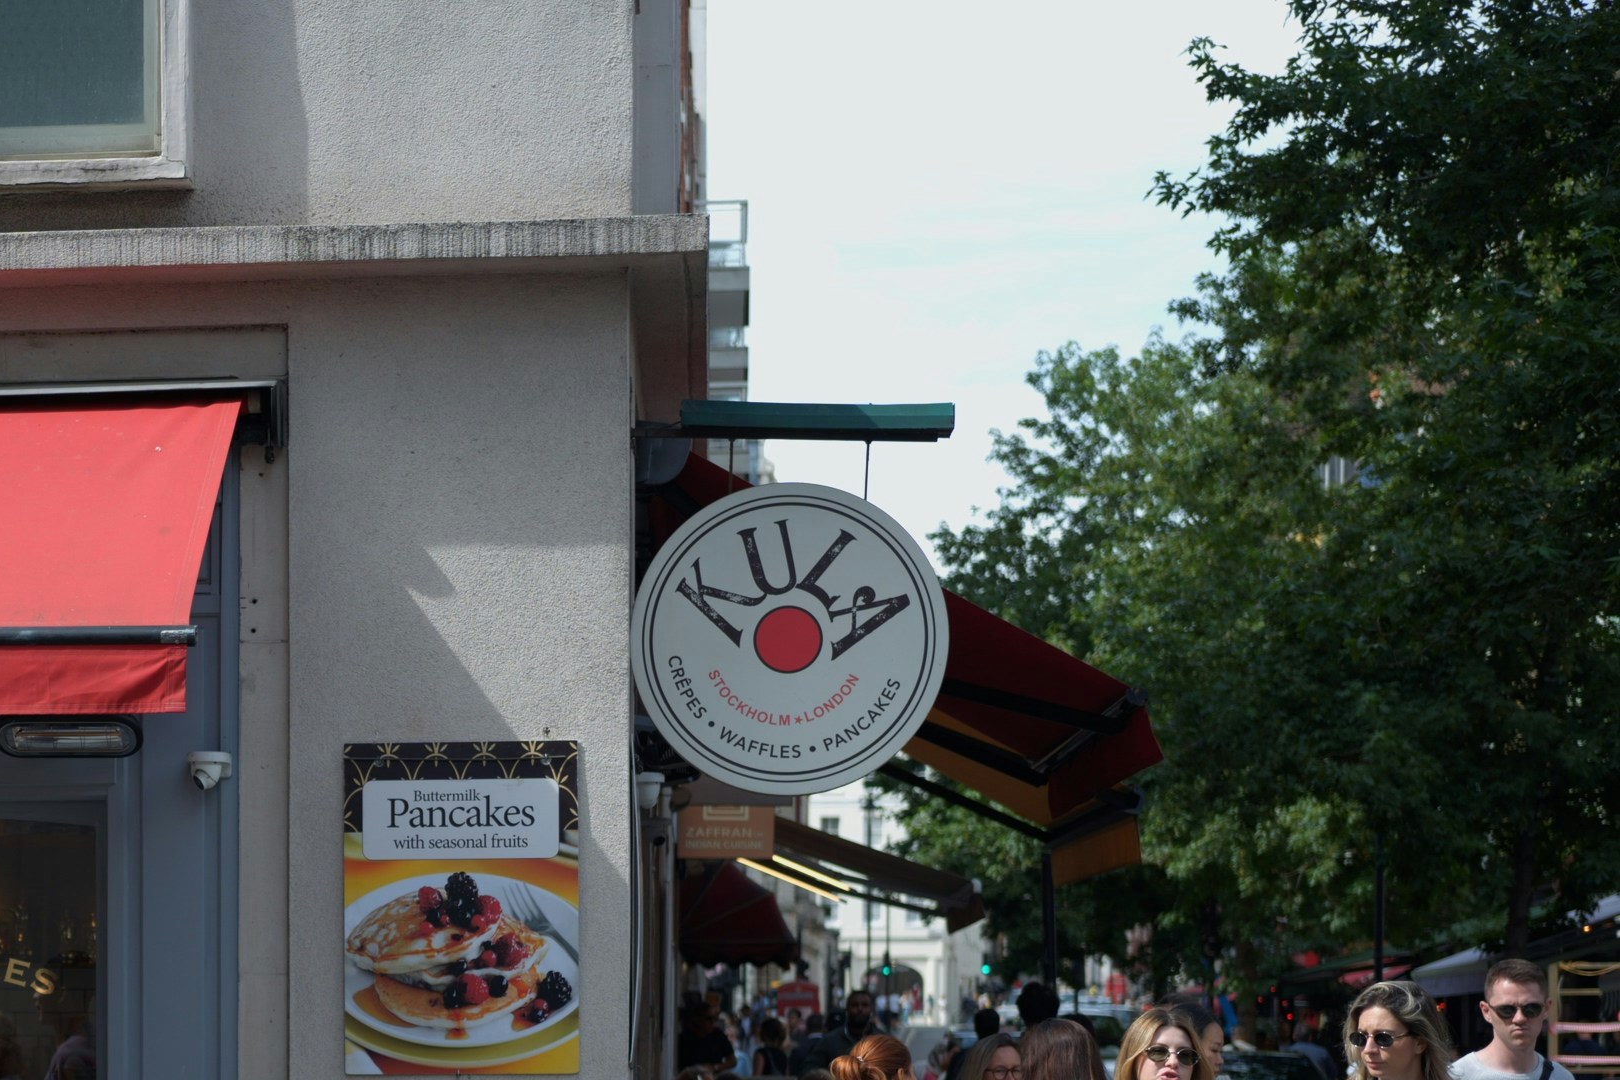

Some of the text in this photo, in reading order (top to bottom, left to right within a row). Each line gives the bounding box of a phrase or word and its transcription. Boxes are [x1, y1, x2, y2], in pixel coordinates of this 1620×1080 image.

[675, 518, 911, 662] KULA
[667, 654, 902, 760] CRÊPES WAFFLES PANCAKES
[386, 795, 536, 829] Pancakes
[413, 789, 481, 803] Buttermilk
[393, 833, 529, 850] with seasonal fruits
